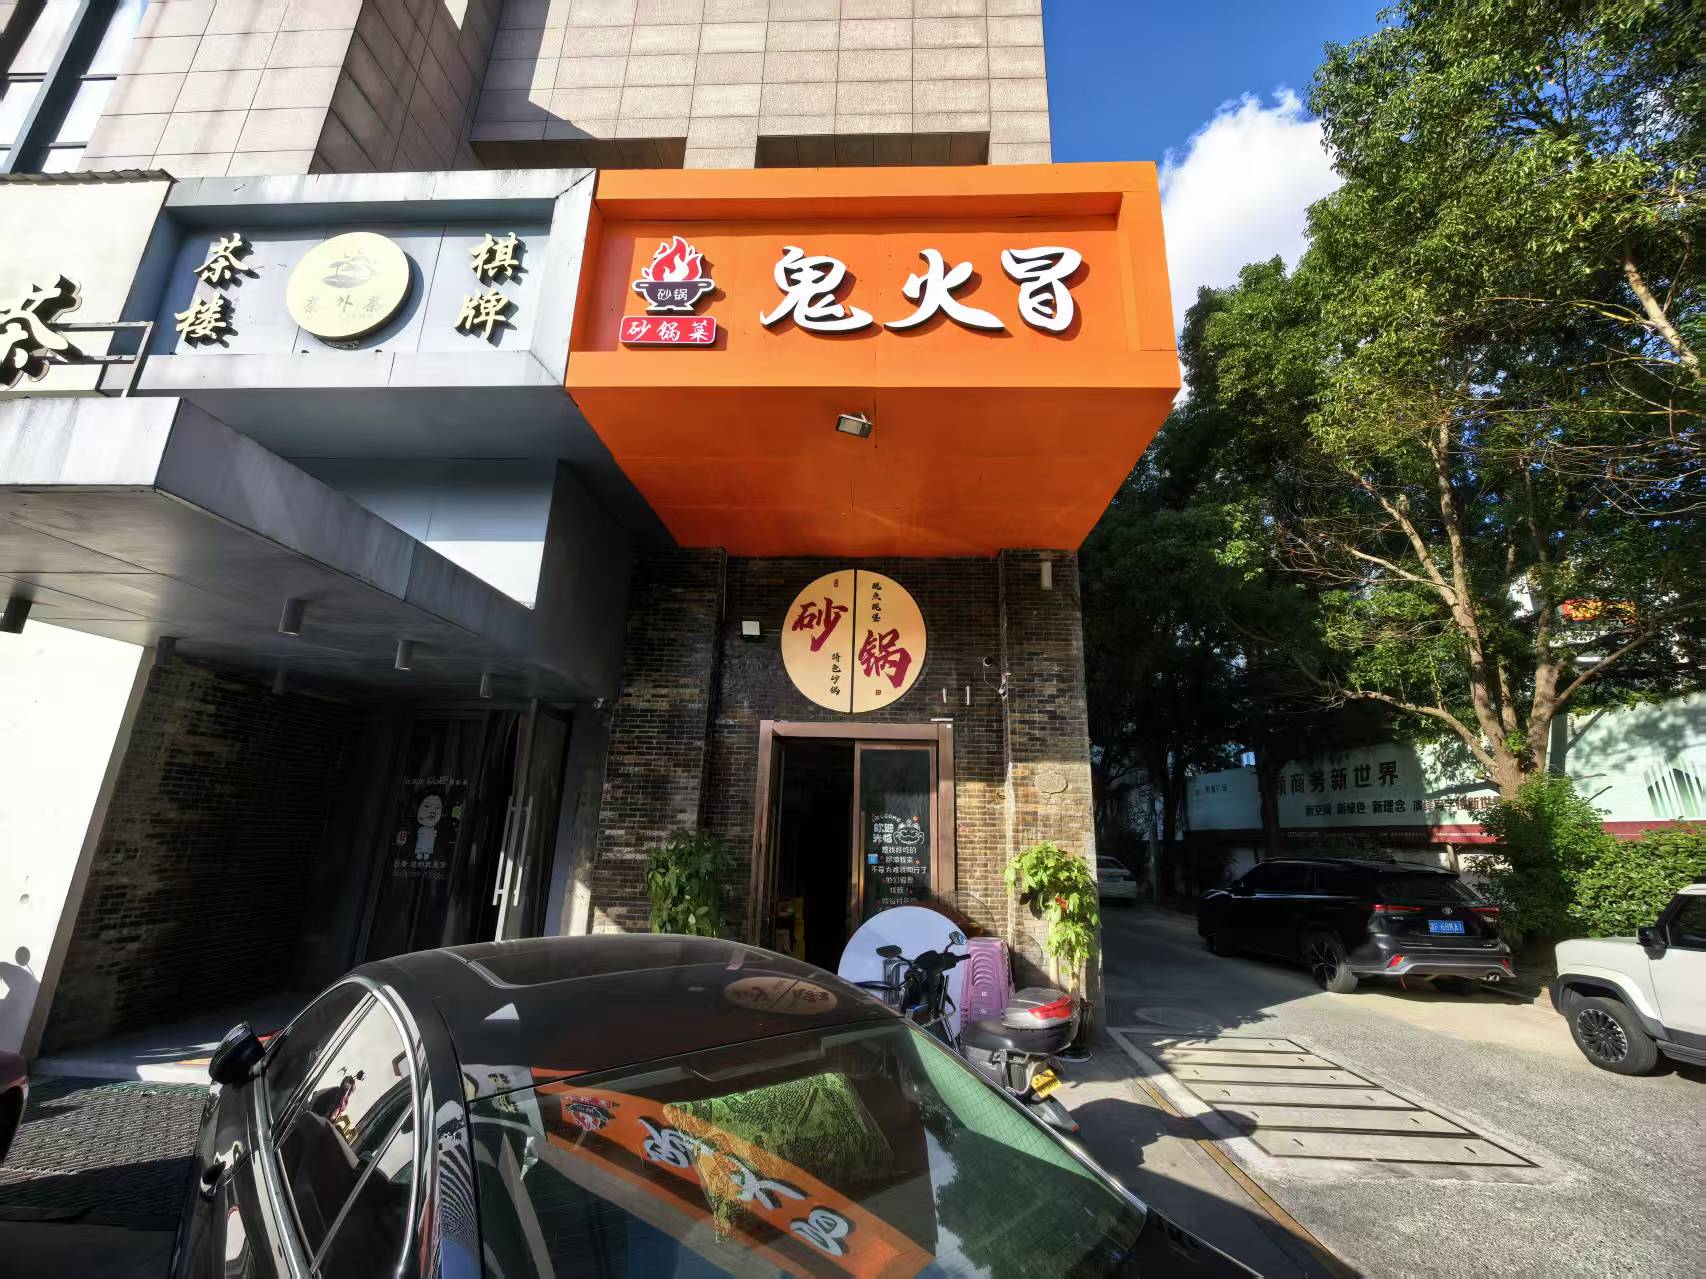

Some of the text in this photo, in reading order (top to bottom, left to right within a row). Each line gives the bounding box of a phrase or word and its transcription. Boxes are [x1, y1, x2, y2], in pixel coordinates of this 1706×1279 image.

[174, 232, 248, 341] 茶楼
[455, 231, 521, 338] 棋牌
[657, 288, 688, 301] 砂锅
[626, 319, 709, 343] 砂锅菜
[1372, 799, 1406, 814] 新理念
